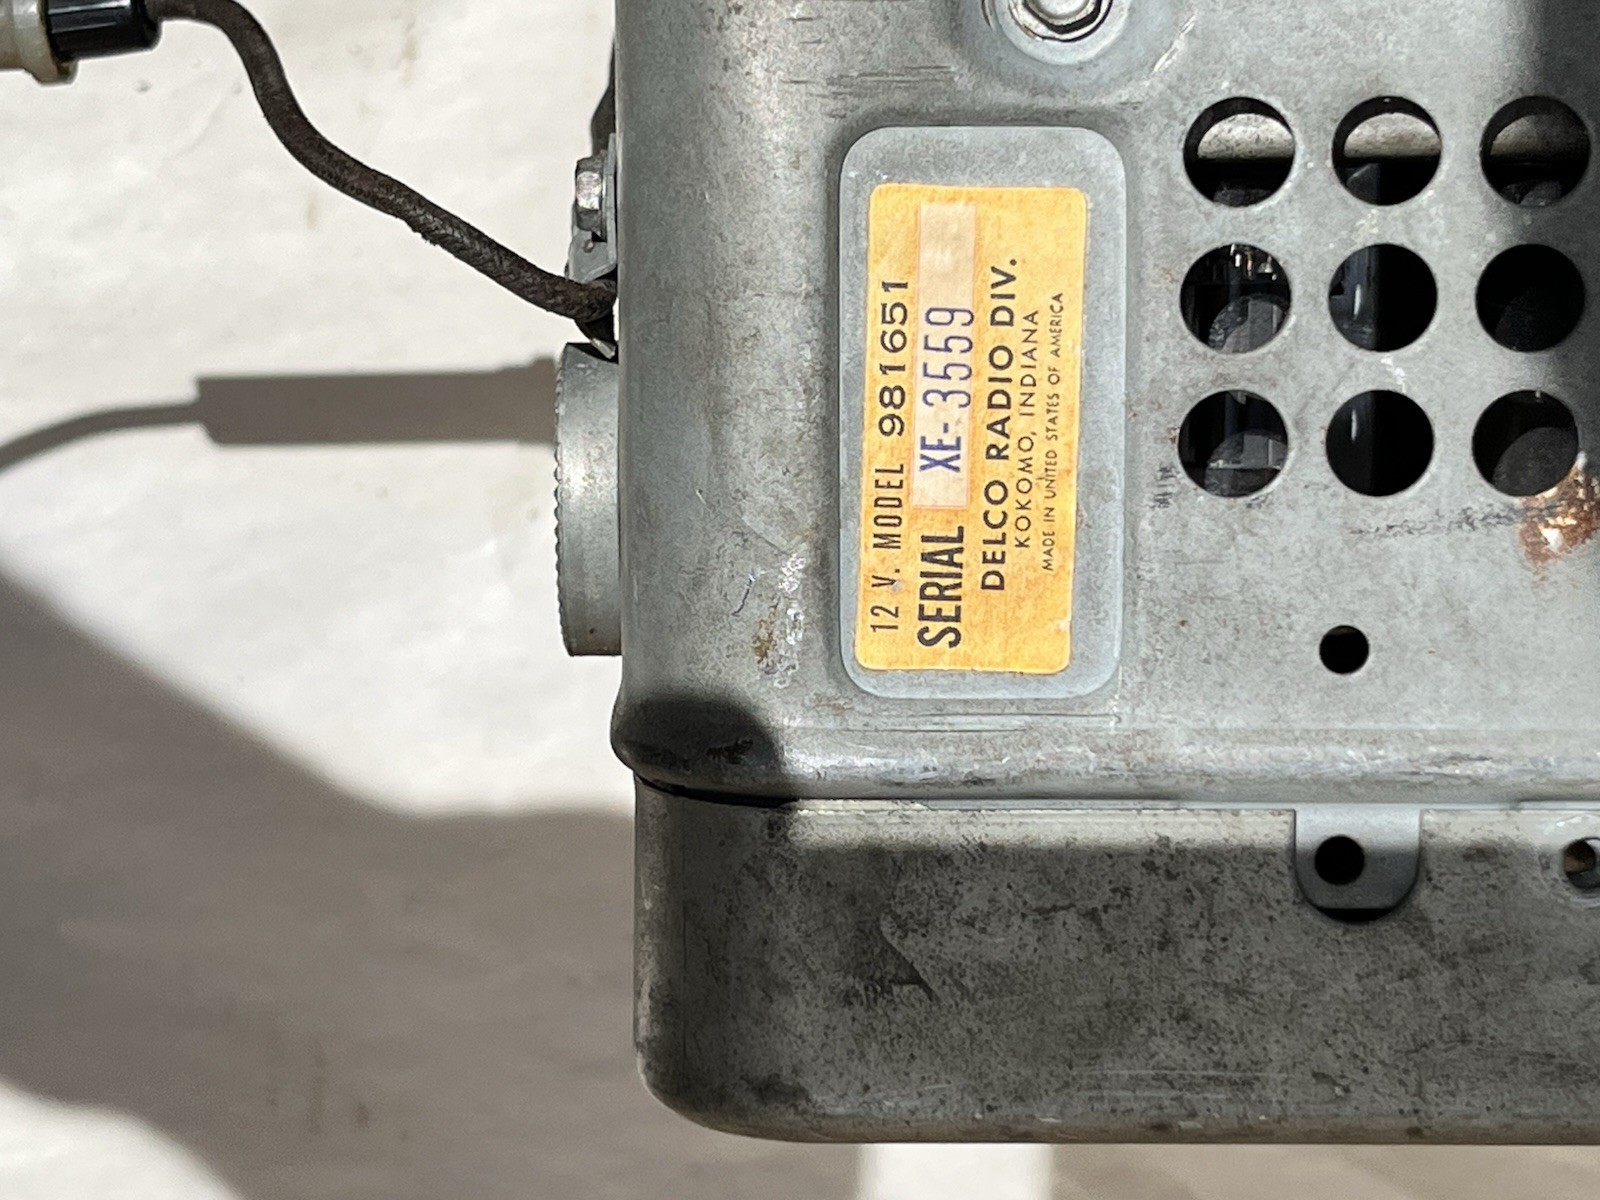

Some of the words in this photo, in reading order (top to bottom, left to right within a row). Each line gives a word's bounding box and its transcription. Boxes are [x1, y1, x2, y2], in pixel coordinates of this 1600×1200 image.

[990, 259, 1017, 327] DIV.
[1049, 292, 1063, 358] AMERICA
[878, 281, 907, 437] 981651
[1019, 310, 1038, 417] INDIANA
[1047, 366, 1060, 385] OF
[985, 345, 1013, 460] RADIO
[1045, 393, 1060, 441] STATES
[873, 464, 903, 549] MODEL
[1014, 431, 1037, 548] KOKOMO,
[1044, 450, 1057, 499] UNITED
[980, 480, 1008, 591] DELCO
[1042, 507, 1055, 523] IN
[871, 569, 900, 588] V.
[1042, 531, 1055, 572] MADE
[870, 606, 899, 632] 12
[917, 525, 963, 648] SERIAL
